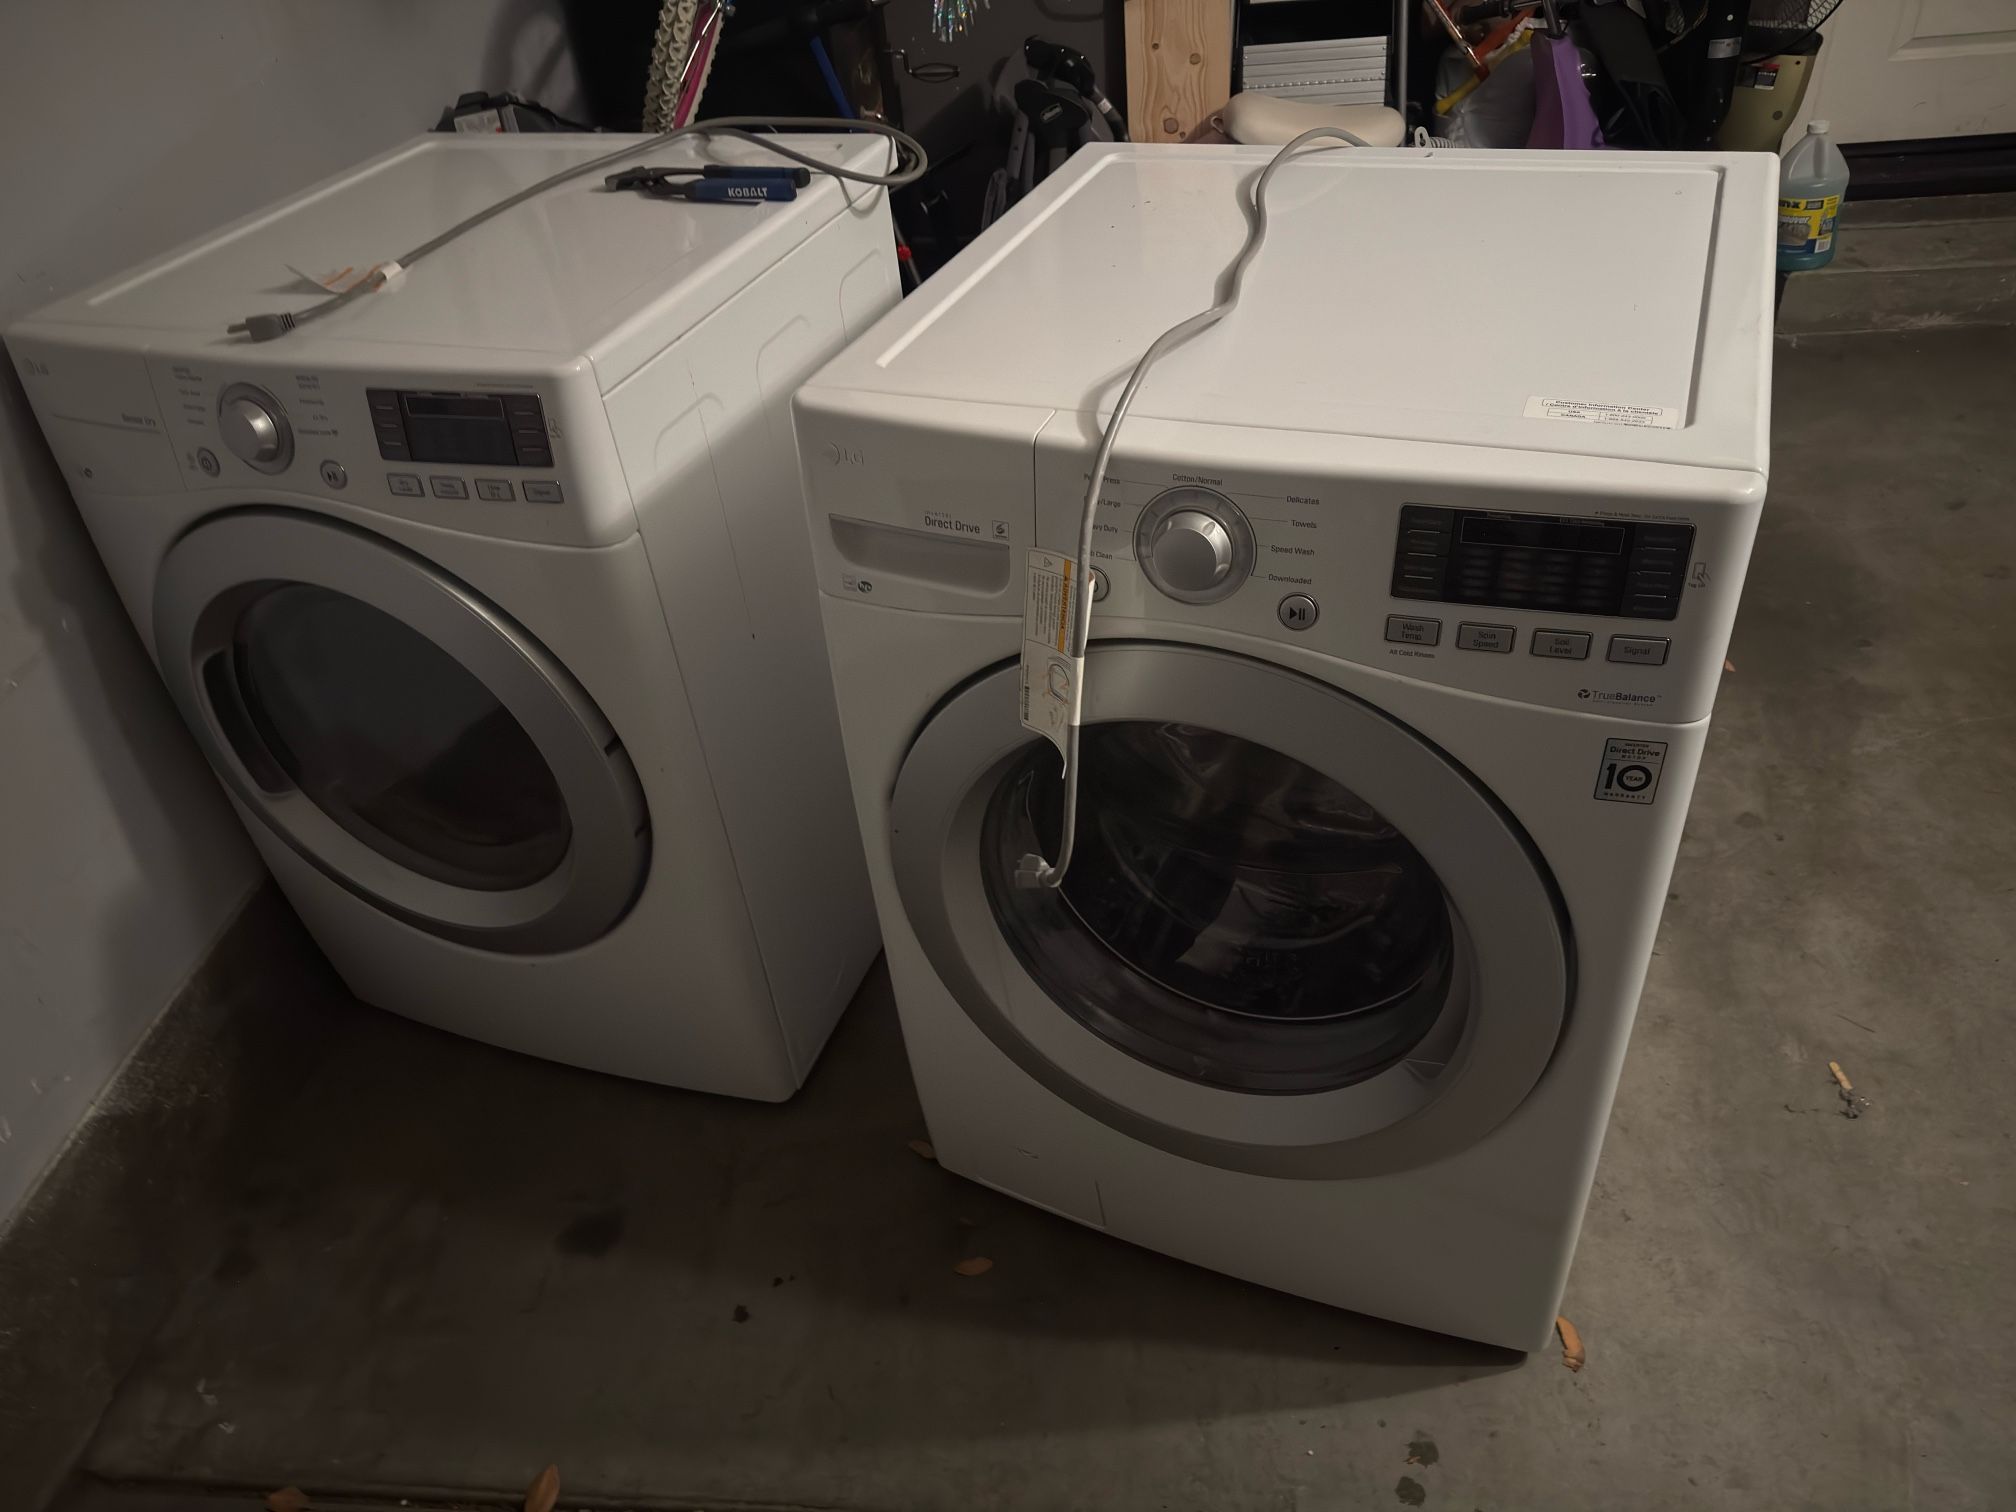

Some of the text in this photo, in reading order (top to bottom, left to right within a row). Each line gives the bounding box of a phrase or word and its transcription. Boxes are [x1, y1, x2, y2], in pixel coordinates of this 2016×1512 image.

[727, 186, 768, 198] KOBALT
[1588, 402, 1626, 410] Information
[1103, 477, 1121, 486] Press
[1172, 474, 1223, 486] Cotton/Normal
[1286, 495, 1320, 506] Delicates
[924, 515, 980, 534] Direct Drive
[1291, 519, 1318, 529] Towels
[1103, 525, 1118, 534] Duty
[1096, 551, 1113, 560] Clean
[1271, 545, 1315, 556] Speed Wash
[1268, 573, 1312, 585] Downloaded
[1402, 623, 1424, 632] Wash
[1478, 630, 1496, 640] Spin
[1472, 638, 1499, 649] Speed
[1554, 637, 1570, 646] Soil
[1399, 649, 1414, 657] Cold
[1550, 645, 1572, 655] Level
[1624, 646, 1651, 656] Signal
[1610, 745, 1661, 757] Direct Drive
[1605, 763, 1653, 792] 10
